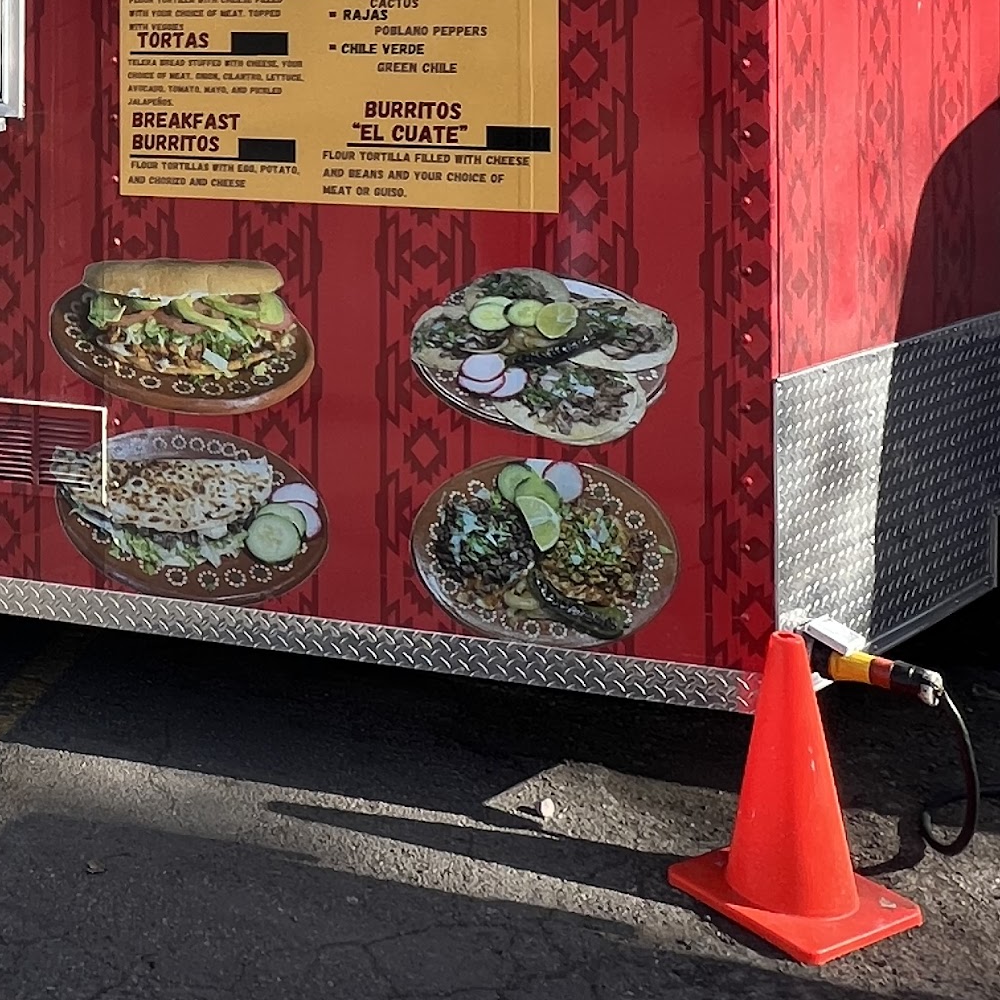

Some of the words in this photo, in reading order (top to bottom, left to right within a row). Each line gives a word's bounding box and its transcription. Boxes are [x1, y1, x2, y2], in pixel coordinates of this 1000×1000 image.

[343, 10, 388, 20] RAJAS
[375, 26, 428, 35] POBLANO
[433, 27, 487, 36] PEPPERS
[137, 32, 209, 48] TORTAS
[342, 43, 377, 54] CHILE
[382, 44, 424, 54] VERDE
[378, 63, 417, 72] GREEN
[422, 63, 457, 73] CHILE
[365, 101, 462, 119] BURRITOS
[132, 112, 240, 130] BREAKFAST
[132, 134, 219, 151] BURRITOS
[323, 151, 355, 160] FLOUR
[361, 152, 410, 162] TORTILLA
[415, 154, 450, 163] FILLED
[455, 155, 481, 164] WITH
[486, 156, 530, 166] CHEESE
[323, 169, 344, 178] AND
[349, 169, 383, 179] BEANS
[388, 171, 409, 180] AND
[414, 172, 442, 181] YOUR
[447, 173, 486, 182] CHOICE
[491, 174, 504, 183] OF
[323, 186, 352, 195] MEAT
[356, 187, 369, 196] OR
[374, 187, 407, 198] GUISO.
